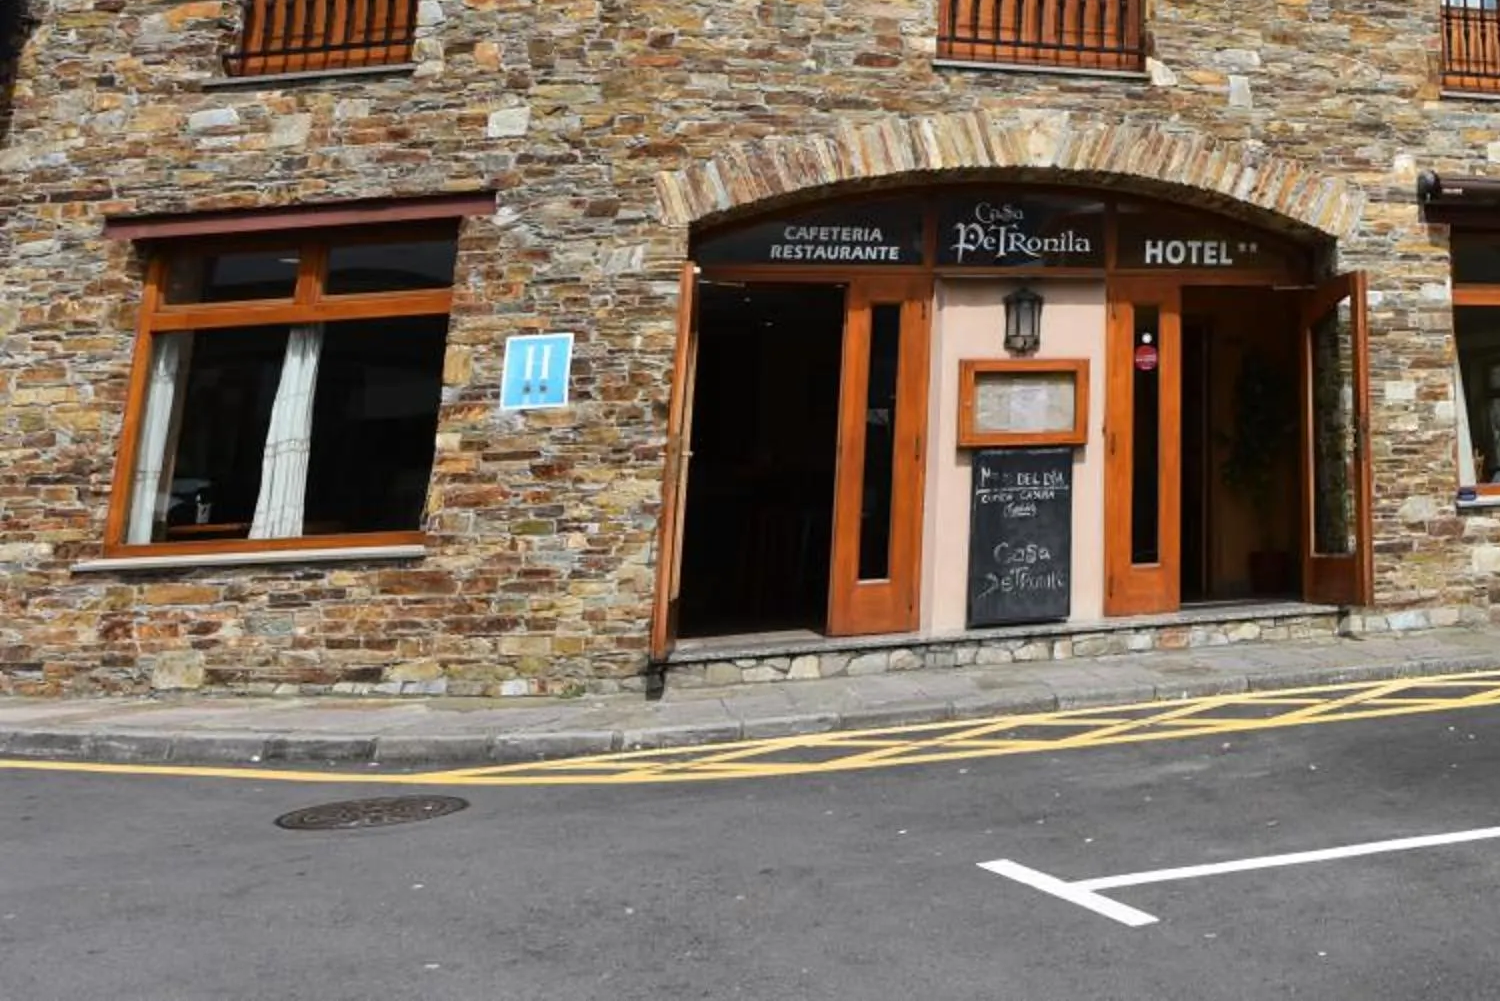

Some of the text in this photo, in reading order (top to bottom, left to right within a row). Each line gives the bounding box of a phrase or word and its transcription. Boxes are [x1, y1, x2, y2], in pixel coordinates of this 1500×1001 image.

[784, 226, 883, 242] CAFETERIA
[770, 244, 900, 260] RESTAURANTE
[1145, 240, 1233, 265] HOTEL
